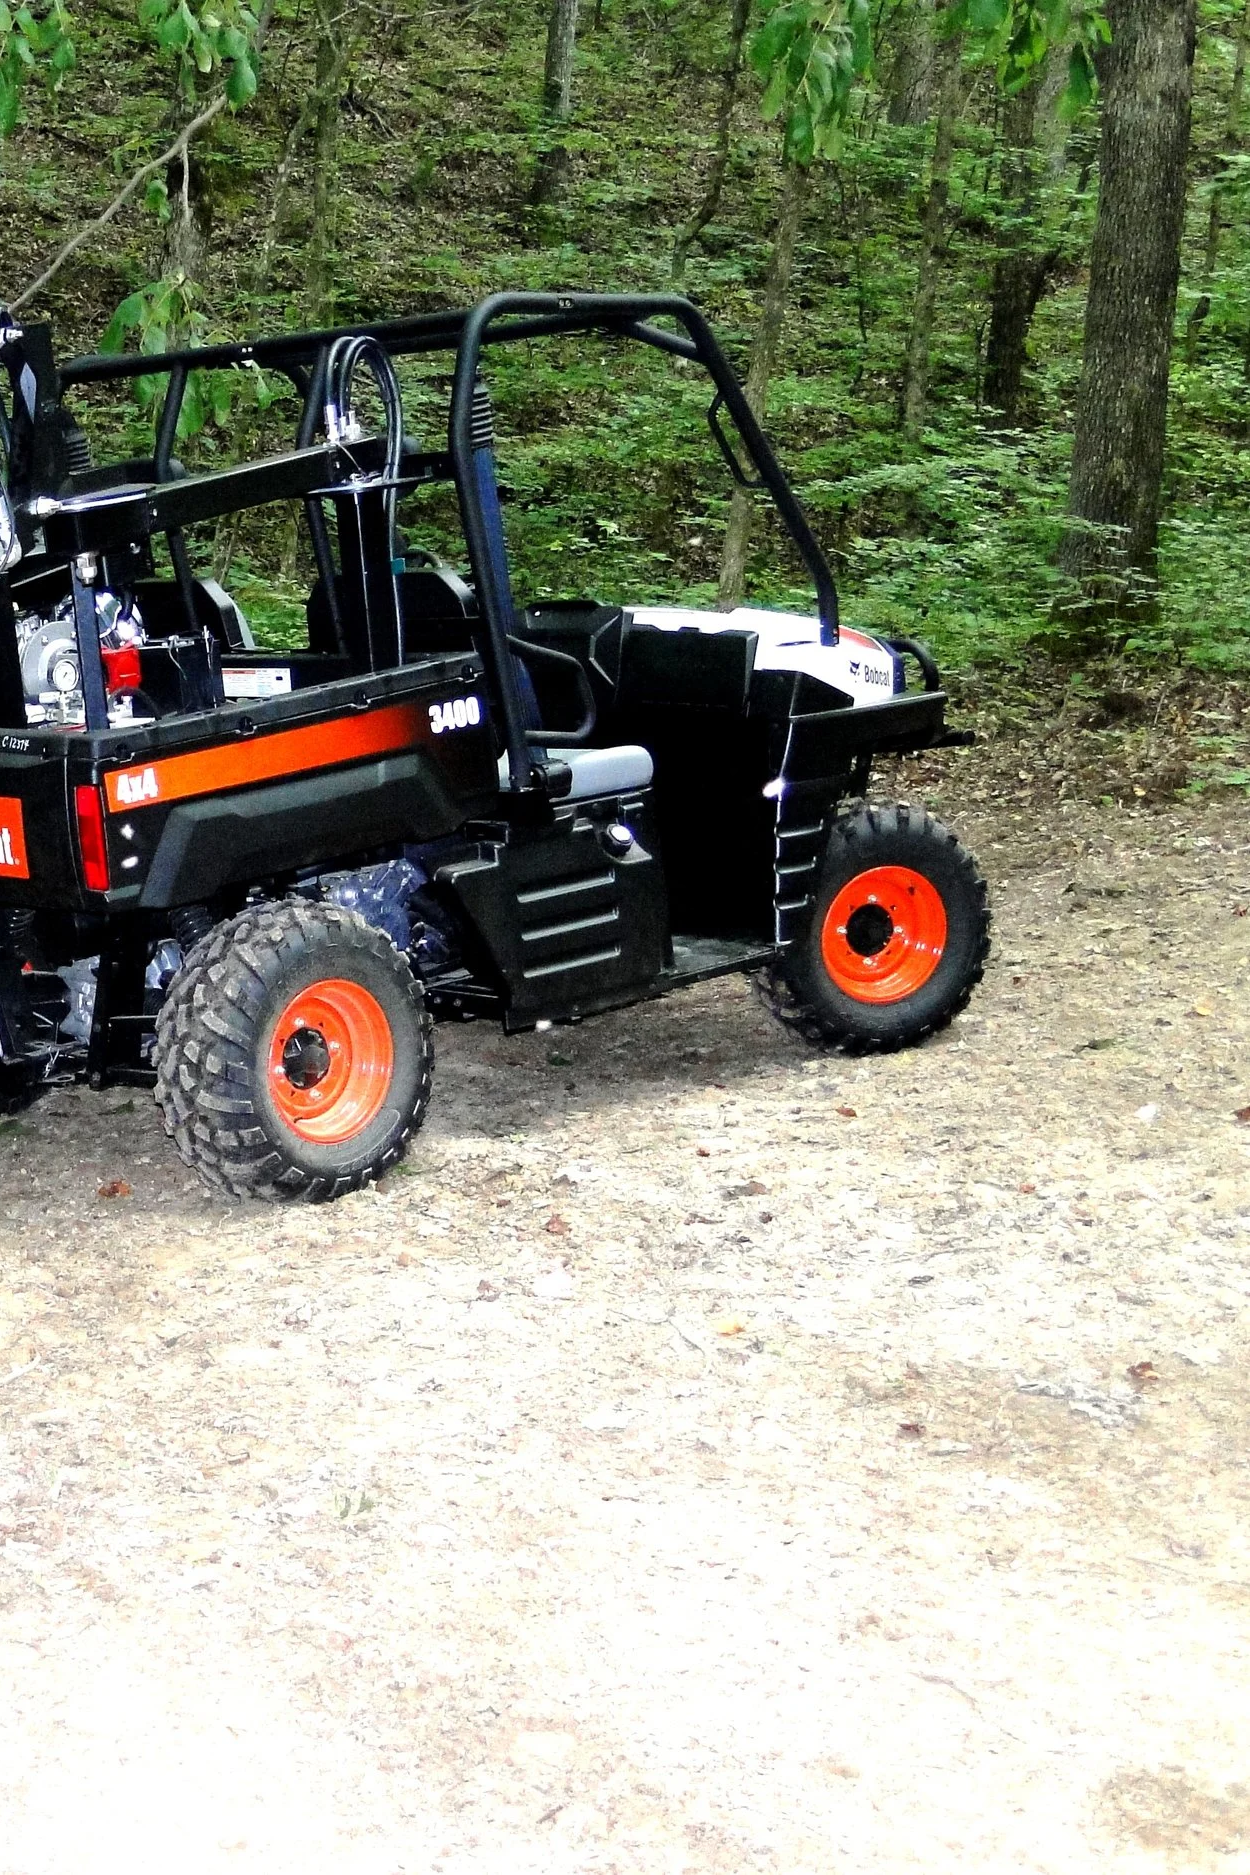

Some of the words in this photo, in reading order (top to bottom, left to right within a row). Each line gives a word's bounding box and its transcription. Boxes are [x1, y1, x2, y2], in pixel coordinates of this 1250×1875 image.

[864, 664, 891, 687] Bobcat
[428, 696, 481, 734] 3400
[116, 767, 159, 804] 4x4
